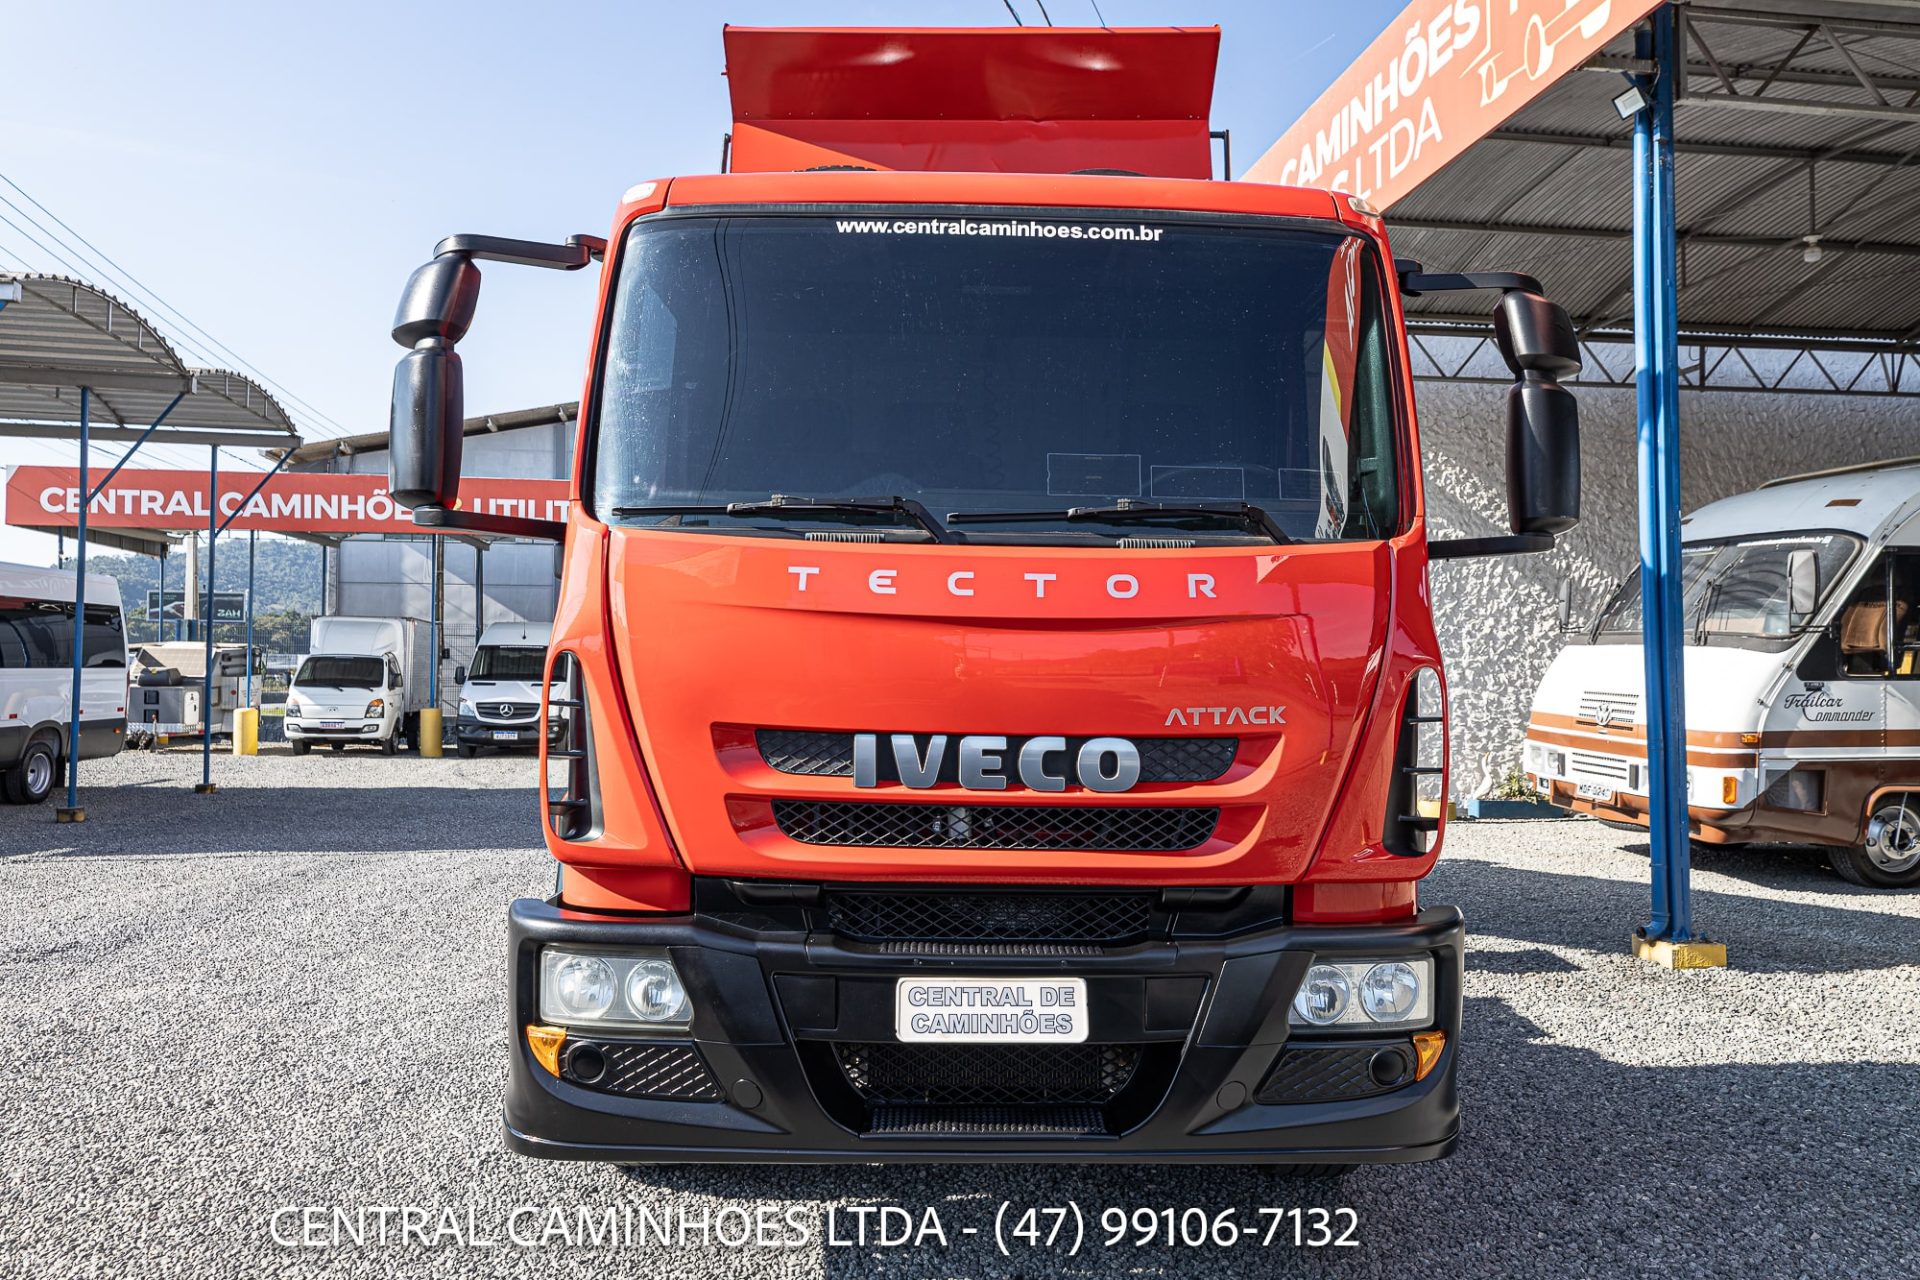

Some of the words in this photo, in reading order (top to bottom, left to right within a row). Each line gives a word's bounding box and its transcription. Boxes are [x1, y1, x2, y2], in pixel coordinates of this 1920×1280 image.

[1280, 0, 1480, 188] CAMINHÕES
[1355, 96, 1443, 200] LTDA
[836, 218, 1163, 241] www.centralcaminhoes.com.br
[39, 486, 209, 516] CENTRAL
[219, 488, 414, 521] CAMINHÕE
[474, 497, 569, 523] UTILIT
[788, 565, 1217, 599] TECTOR
[1164, 705, 1287, 727] ATTACK
[853, 733, 1141, 793] IVECO
[908, 986, 1033, 1007] CENTRAL
[1040, 986, 1075, 1007] DE
[911, 1009, 1073, 1035] CAMINHÕES
